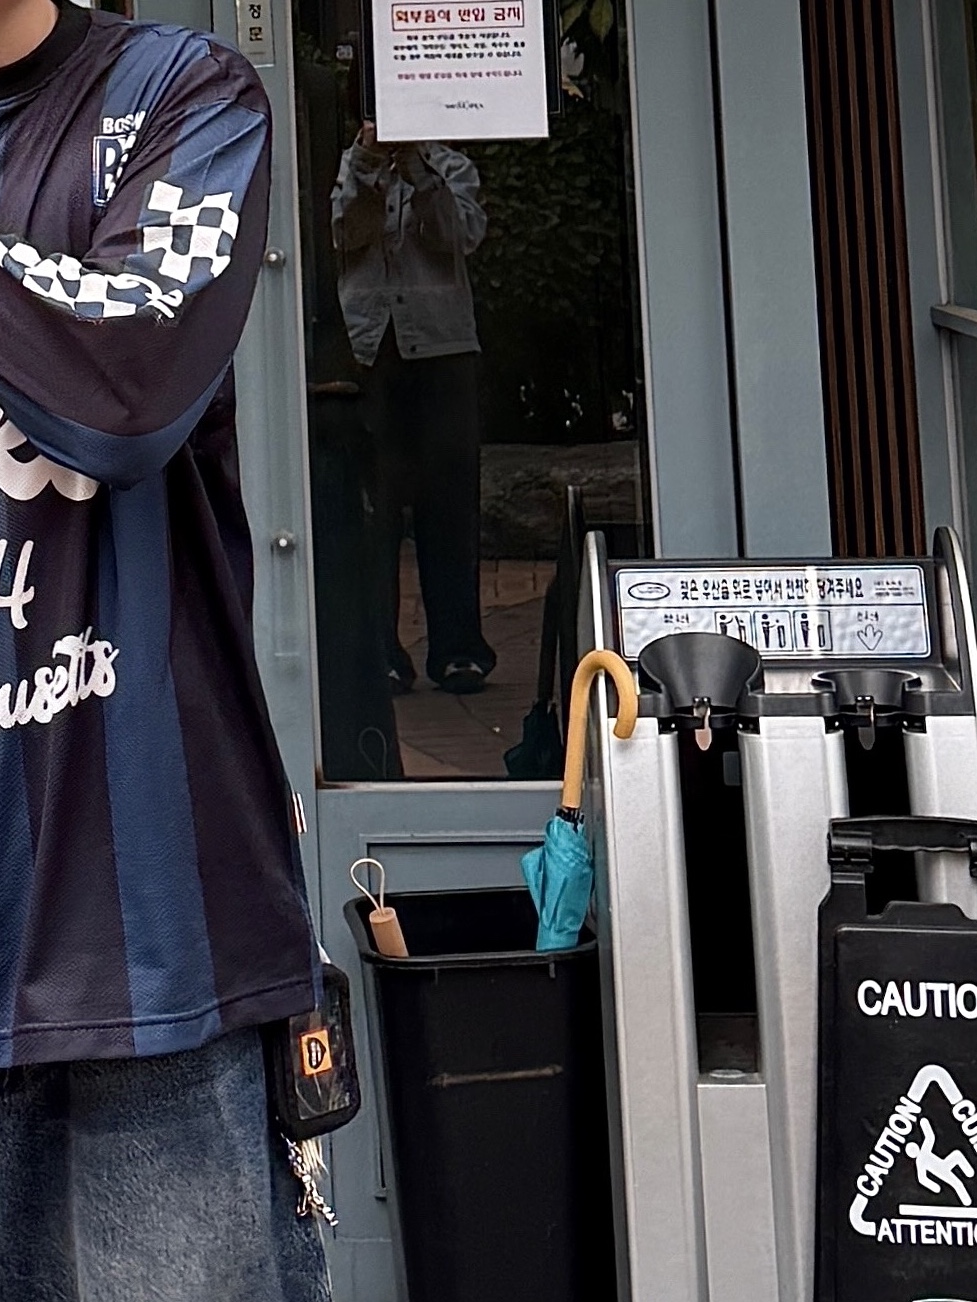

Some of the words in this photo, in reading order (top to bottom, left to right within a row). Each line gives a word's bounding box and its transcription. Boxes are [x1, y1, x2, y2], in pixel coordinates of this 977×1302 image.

[702, 579, 730, 601] 우산을
[857, 979, 977, 1019] CAUTIO
[856, 1095, 922, 1197] CAUTION
[877, 1217, 977, 1247] ATTENTI
